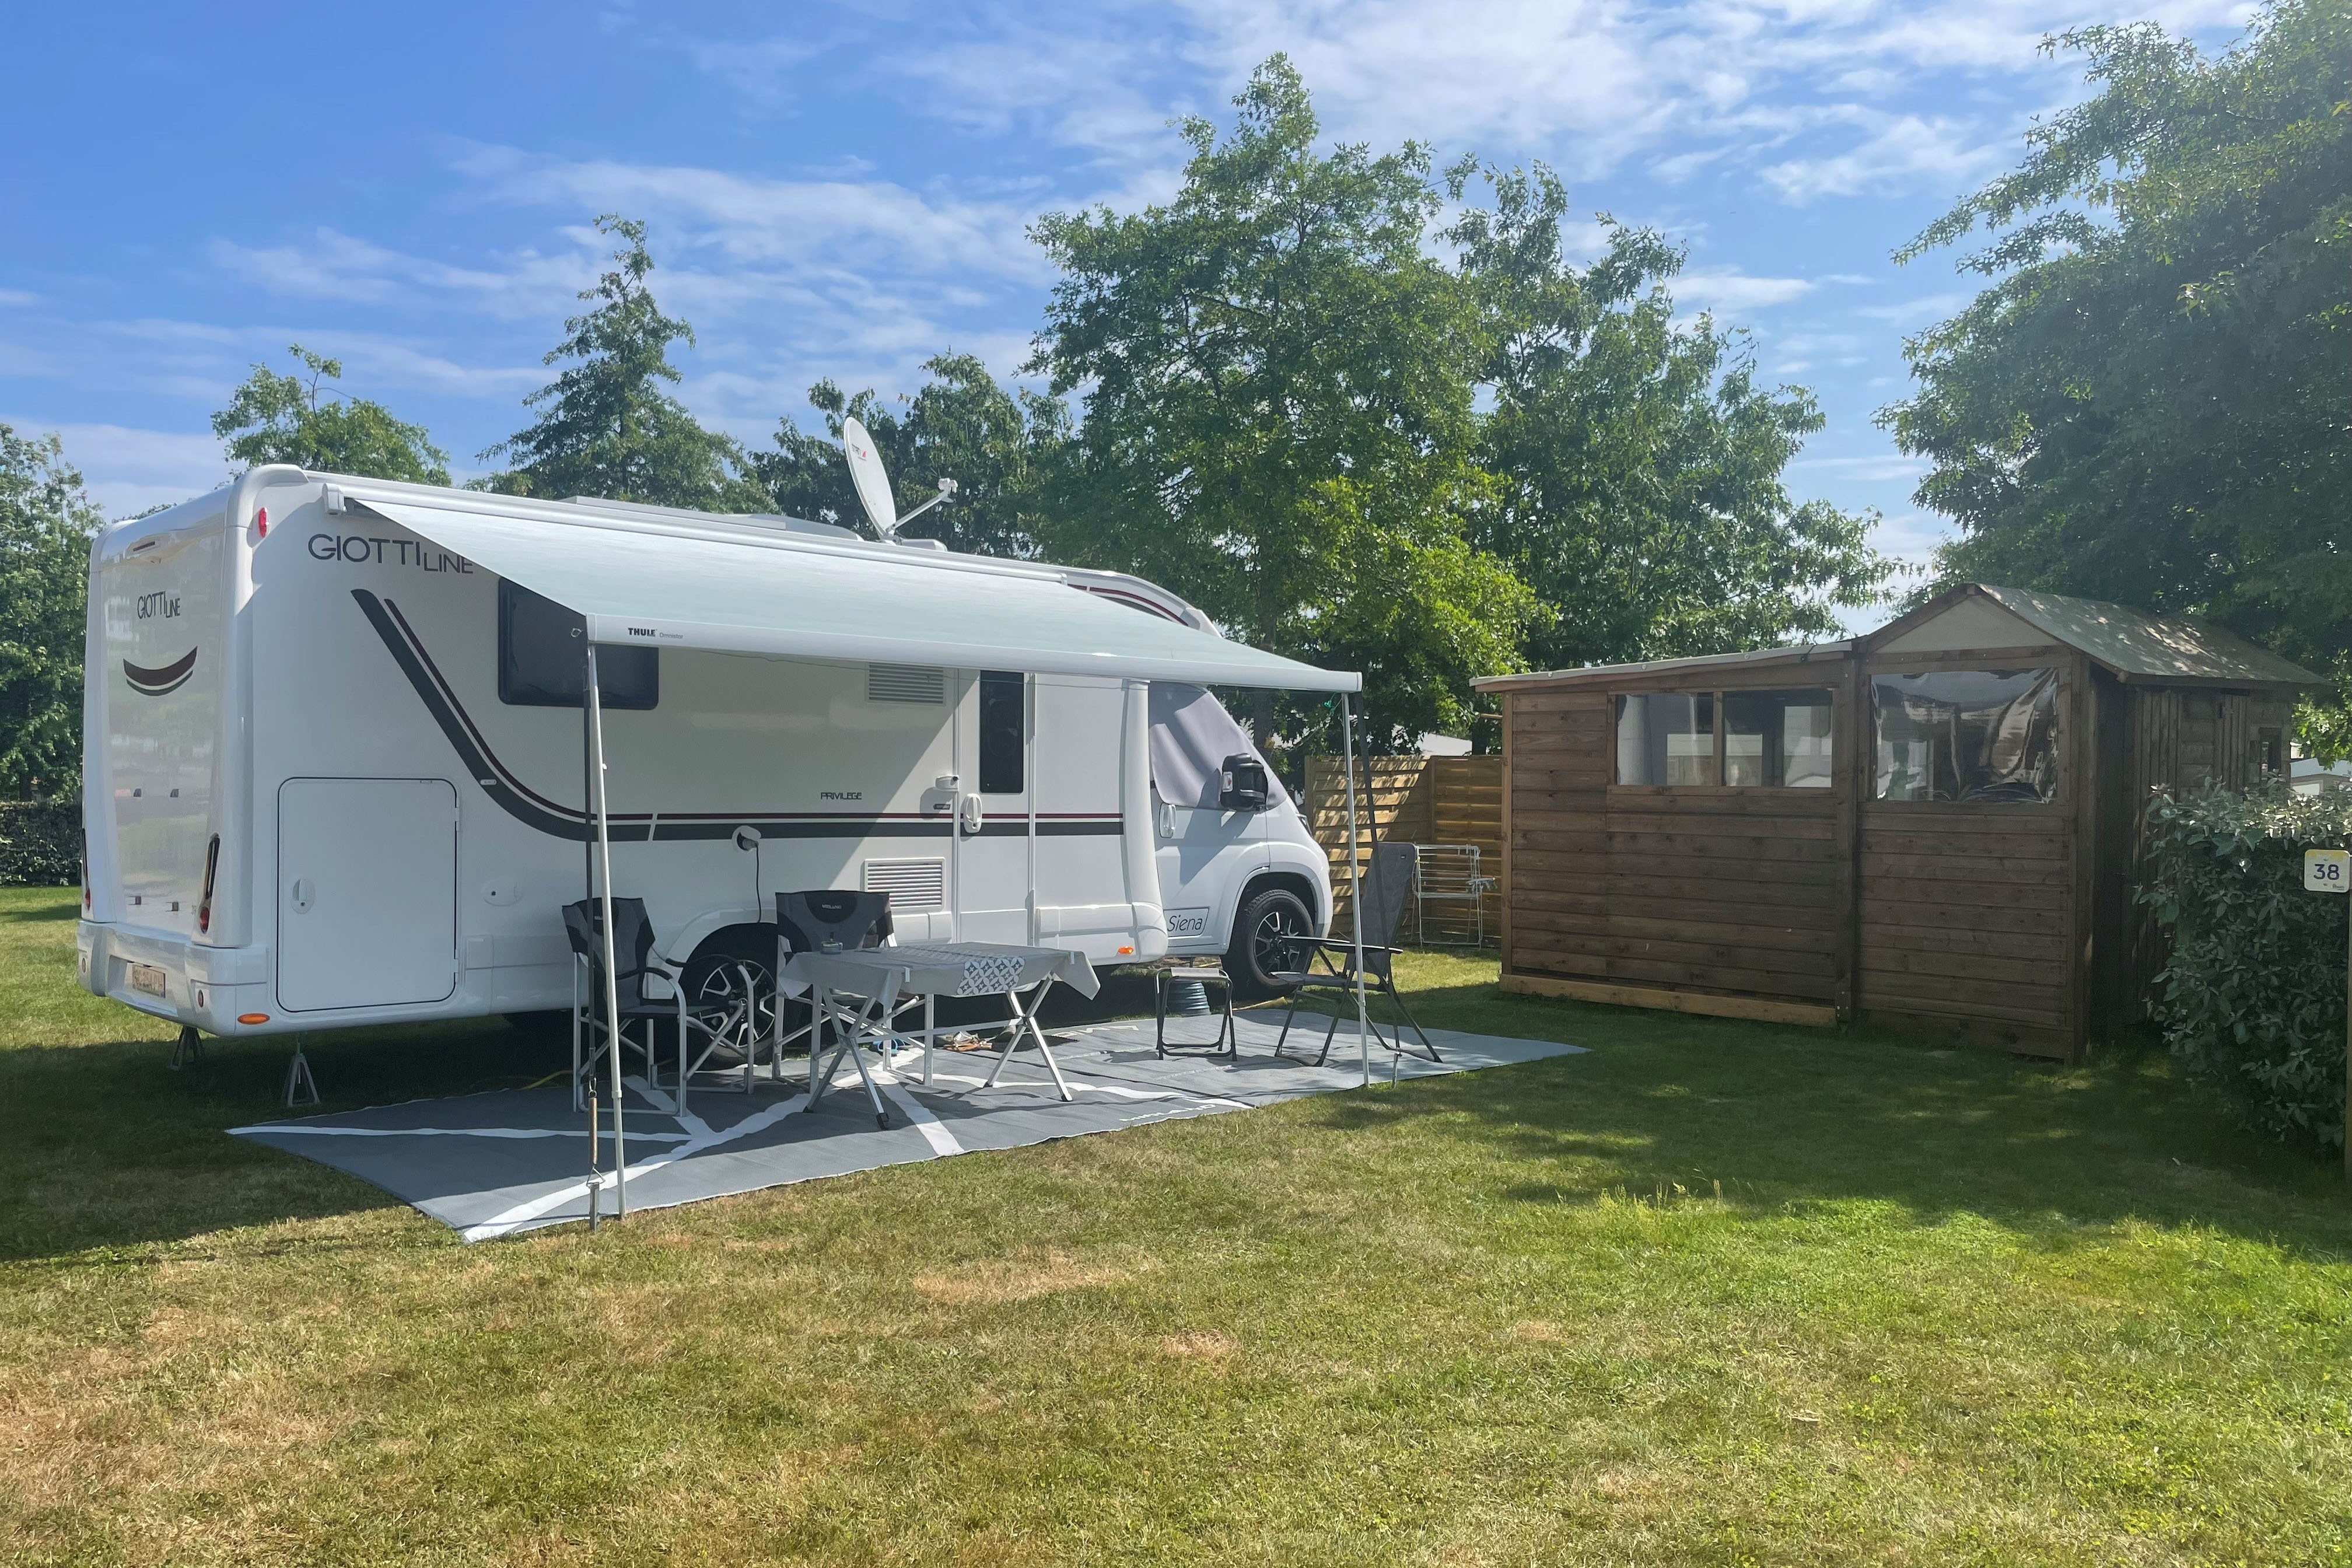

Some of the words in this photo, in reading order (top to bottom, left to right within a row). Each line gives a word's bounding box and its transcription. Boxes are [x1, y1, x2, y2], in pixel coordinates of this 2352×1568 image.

[628, 627, 656, 637] THULE
[2314, 863, 2340, 880] 38
[1167, 914, 1203, 932] Siena
